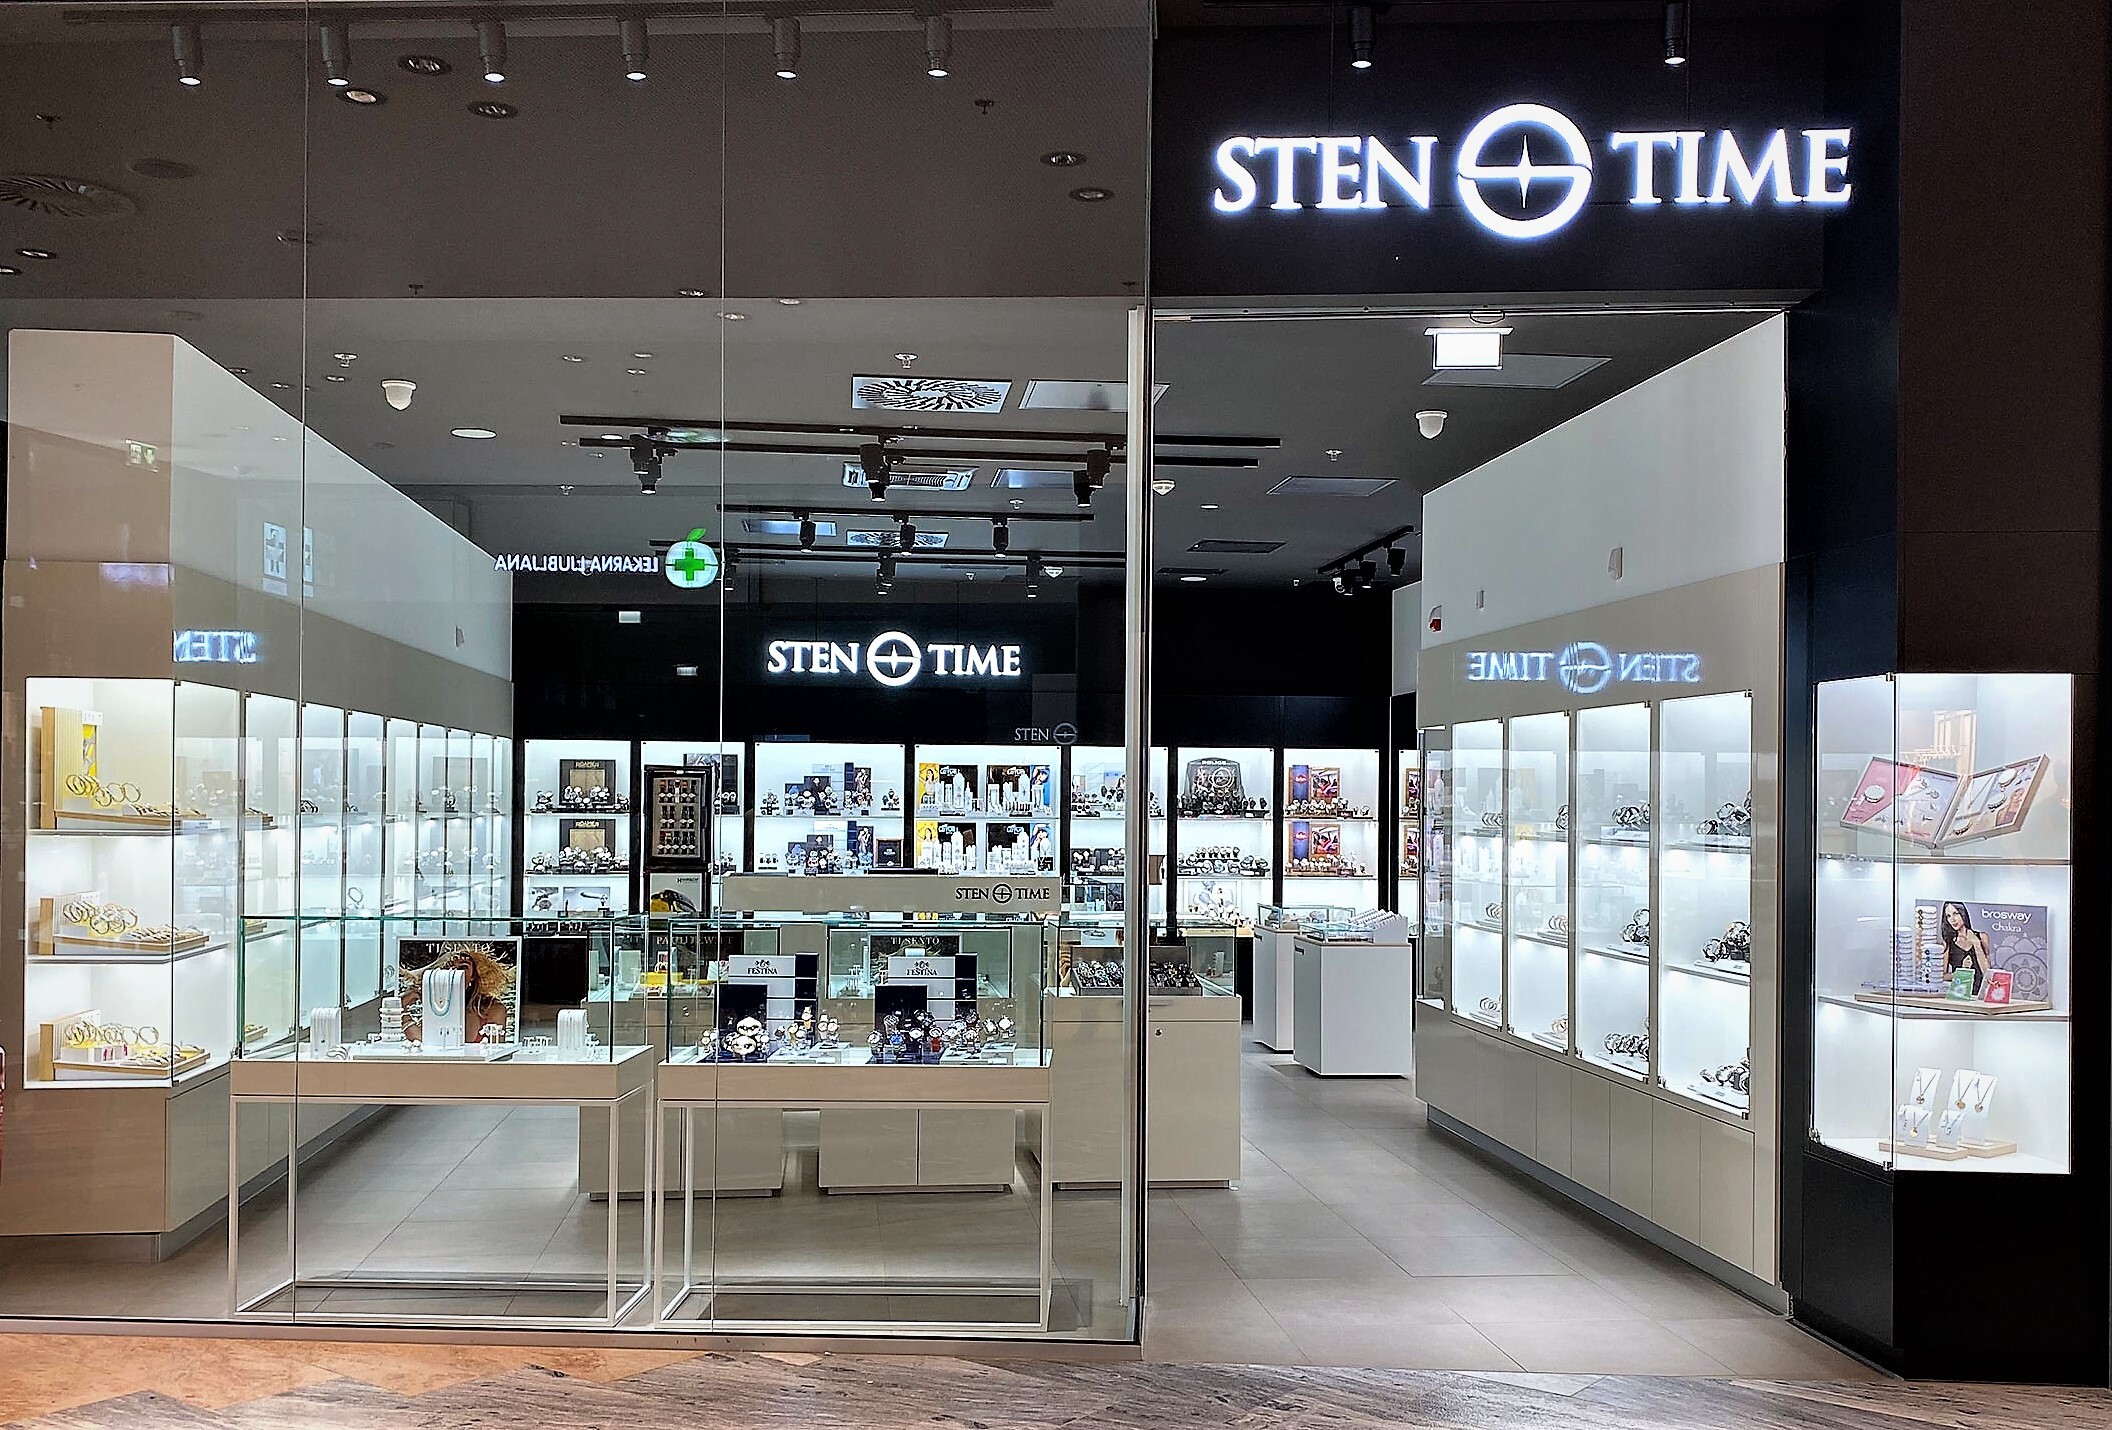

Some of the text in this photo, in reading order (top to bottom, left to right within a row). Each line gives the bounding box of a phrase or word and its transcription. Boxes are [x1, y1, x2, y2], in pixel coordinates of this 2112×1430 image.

[1213, 128, 1853, 212] STEN TIME
[767, 640, 1022, 676] STEN TIME
[1013, 727, 1049, 741] STEN
[955, 887, 1050, 900] STEN TIME
[1981, 908, 2032, 924] brosway
